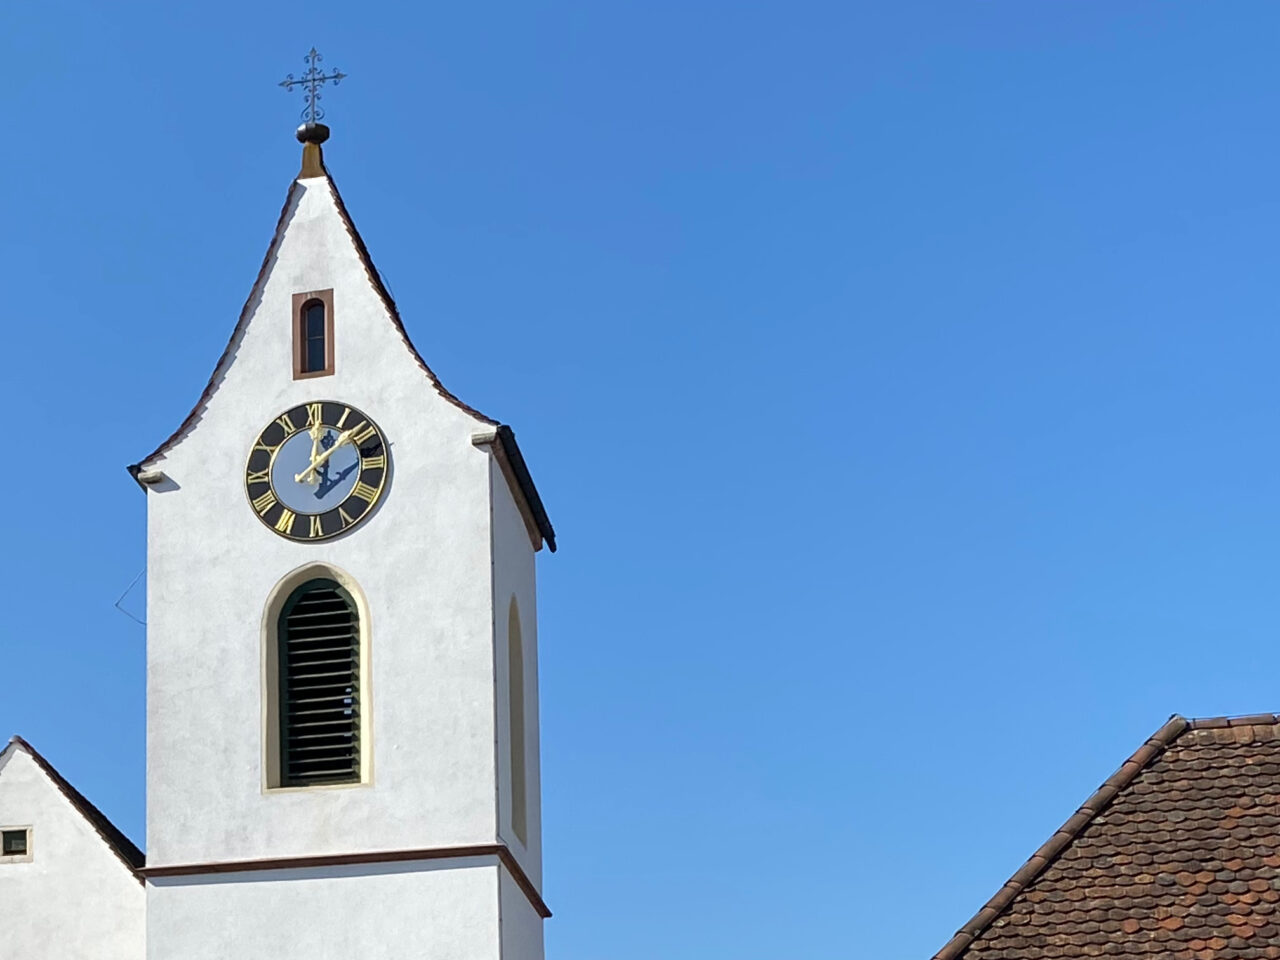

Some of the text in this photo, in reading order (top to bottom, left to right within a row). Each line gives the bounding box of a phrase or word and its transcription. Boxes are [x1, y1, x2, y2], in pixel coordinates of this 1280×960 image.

[305, 403, 323, 425] XII
[336, 407, 352, 428] I
[254, 438, 276, 457] X
[362, 455, 384, 471] III
[338, 507, 355, 528] V
